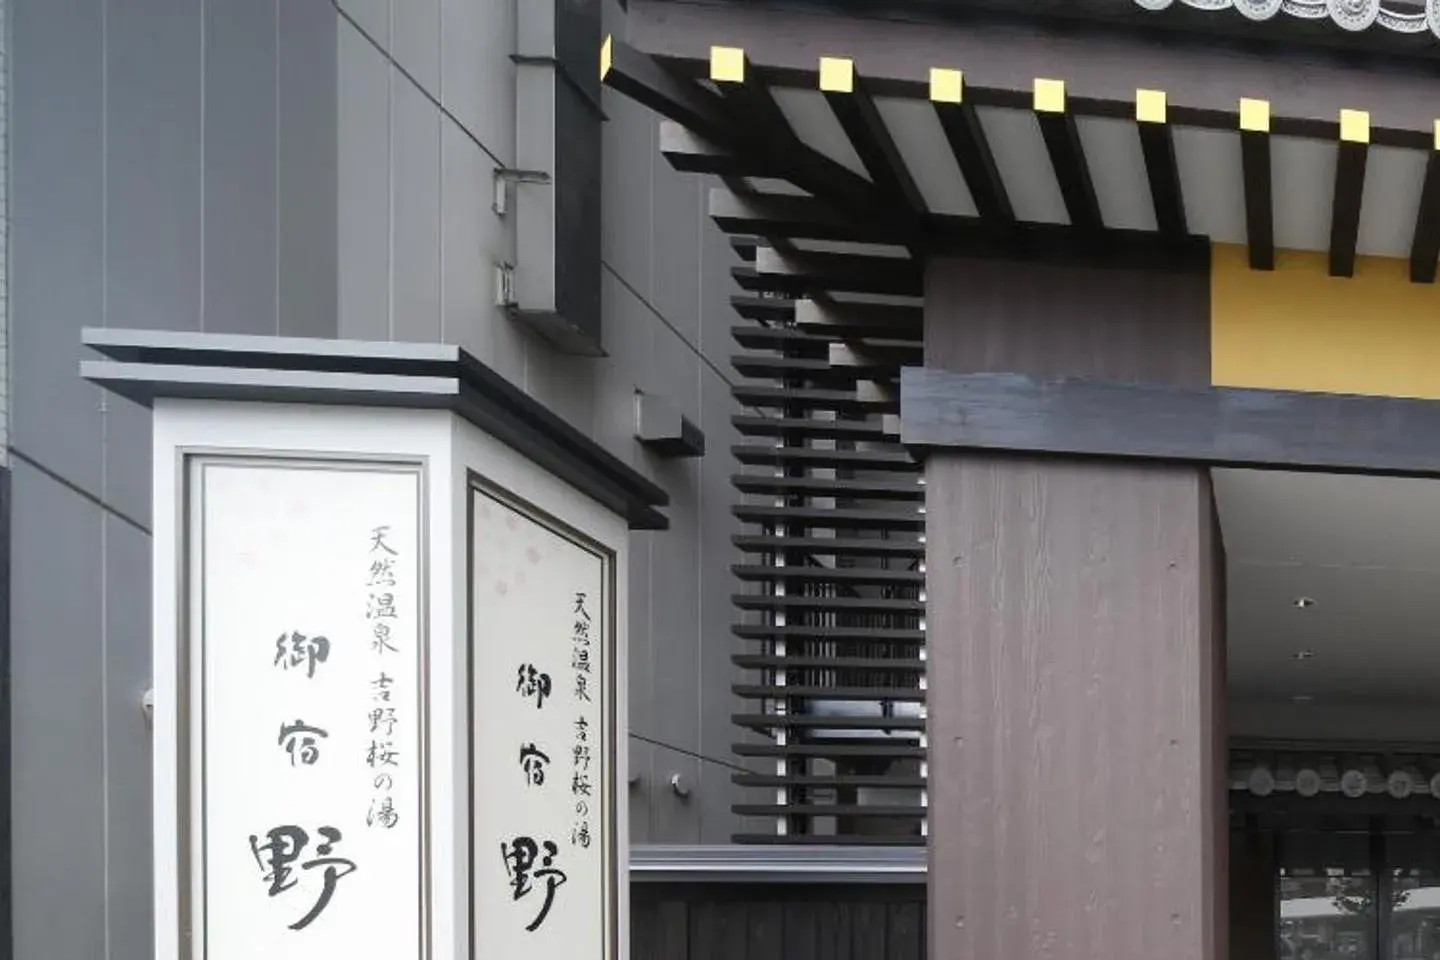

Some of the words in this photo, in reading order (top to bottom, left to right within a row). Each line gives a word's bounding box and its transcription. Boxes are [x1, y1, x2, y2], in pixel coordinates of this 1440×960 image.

[366, 525, 399, 654] 天然温泉
[571, 592, 592, 702] 天然温泉
[366, 671, 400, 830] 吉野桜の湯
[571, 715, 592, 849] 吉野桜の湯
